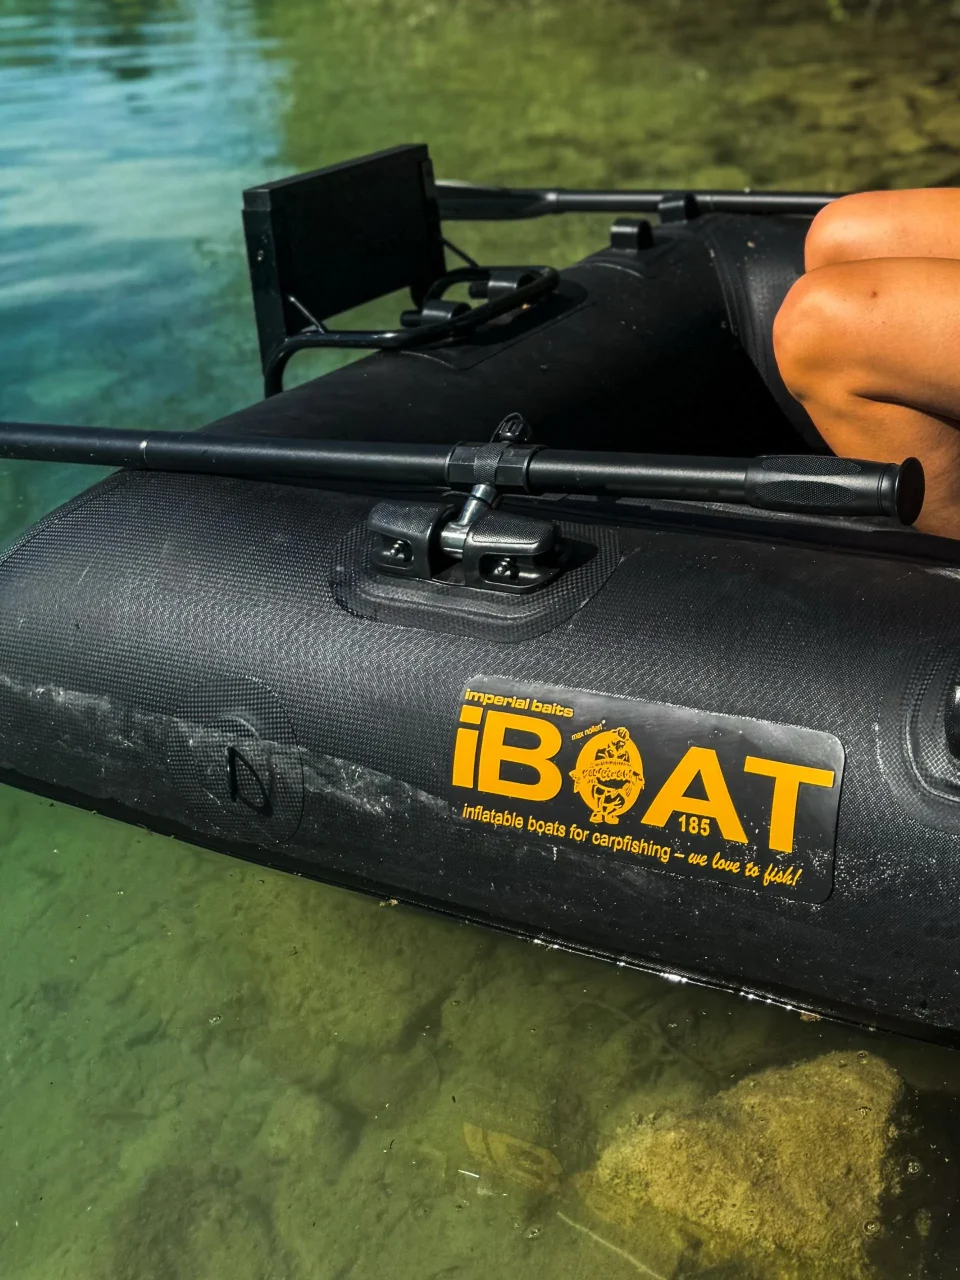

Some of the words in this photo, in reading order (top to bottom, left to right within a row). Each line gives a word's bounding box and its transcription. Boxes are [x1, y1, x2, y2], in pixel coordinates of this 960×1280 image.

[464, 689, 530, 710] imperial
[531, 699, 574, 718] baits
[678, 814, 711, 837] 185
[462, 803, 524, 829] inflatable
[527, 815, 566, 838] boats
[569, 824, 589, 842] for
[592, 832, 671, 863] carpfishing
[688, 852, 708, 866] we
[712, 852, 740, 874] love
[745, 862, 760, 877] to
[763, 863, 803, 887] fish!
